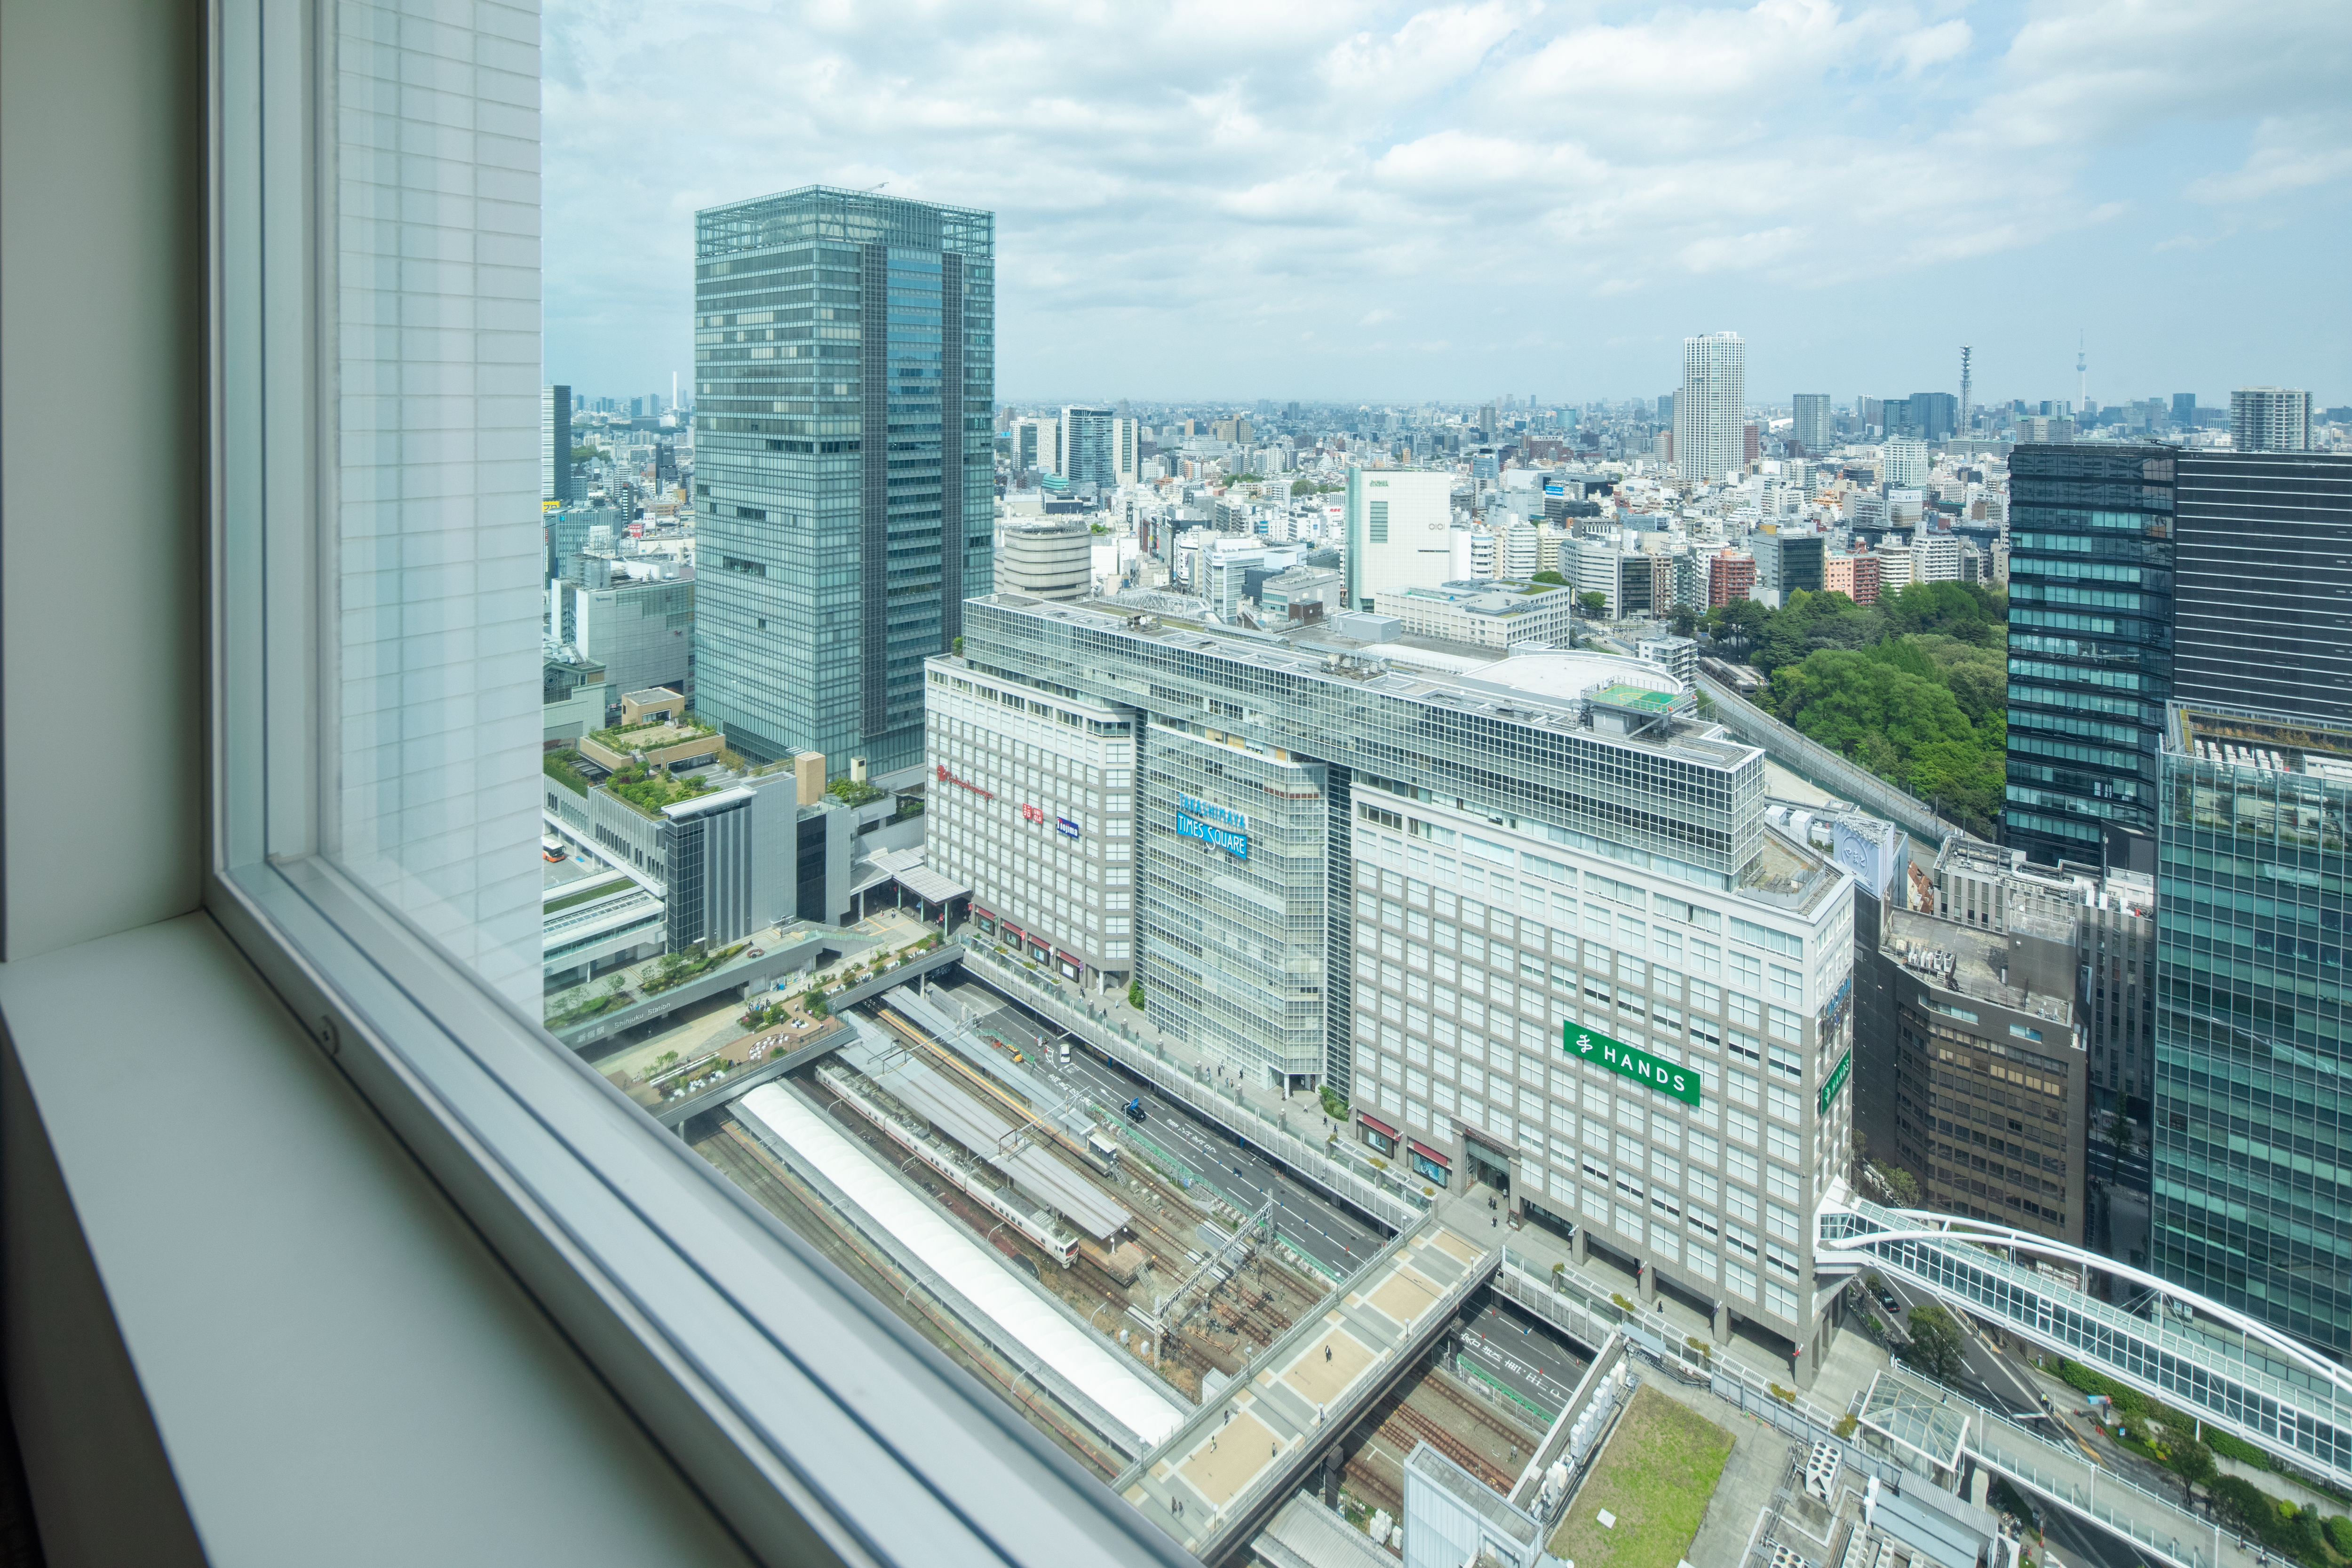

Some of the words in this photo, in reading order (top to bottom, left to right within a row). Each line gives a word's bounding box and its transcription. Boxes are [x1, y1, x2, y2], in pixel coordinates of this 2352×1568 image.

[1179, 793, 1245, 830] TAKASHIMAYA
[1178, 815, 1204, 838] TIMES
[1206, 827, 1245, 854] SQUARE
[1844, 847, 1866, 868] やまと
[614, 1012, 644, 1028] Shinjuku
[648, 1002, 670, 1015] Station
[577, 1026, 605, 1043] 新宿駅
[1605, 1045, 1685, 1091] HANDS
